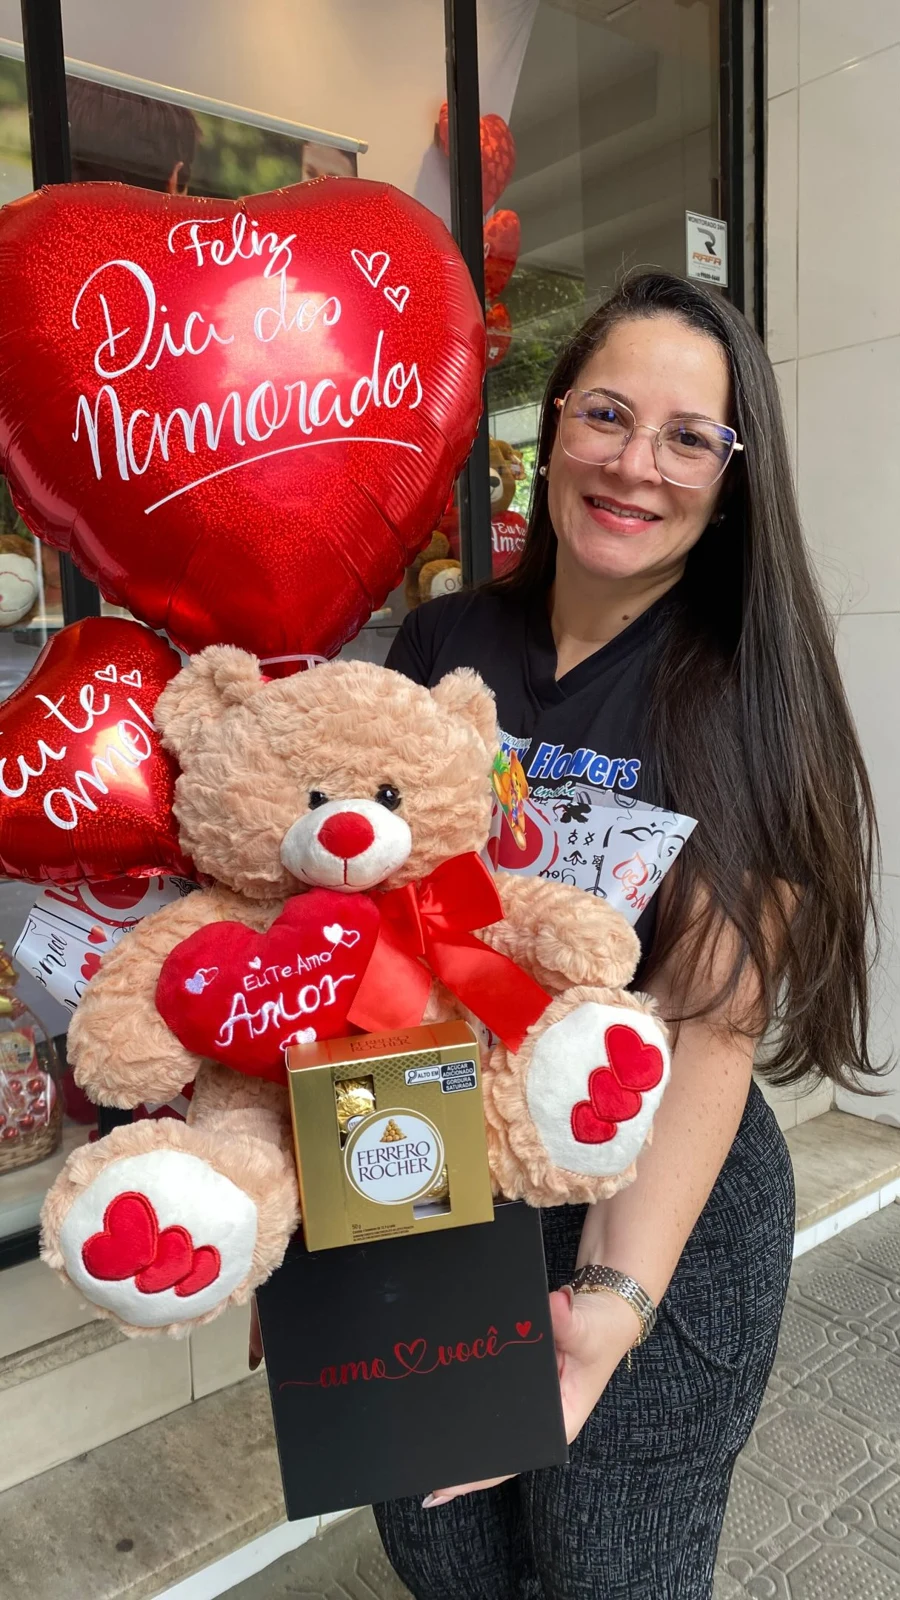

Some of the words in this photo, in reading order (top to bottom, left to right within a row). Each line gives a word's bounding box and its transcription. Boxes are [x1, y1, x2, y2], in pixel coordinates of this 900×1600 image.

[168, 212, 297, 278] Feliz
[72, 260, 234, 379] Dia
[254, 268, 342, 342] dos
[72, 330, 423, 481] Namorados
[35, 684, 110, 733] te
[297, 951, 333, 976] Amo
[215, 974, 356, 1047] Amor
[443, 1068, 474, 1077] ADICIONADO
[446, 1076, 472, 1085] GORDURA
[446, 1082, 473, 1091] SATURADA
[357, 1140, 431, 1166] FERRERO
[358, 1157, 433, 1182] ROCHER
[319, 1357, 386, 1388] amo
[437, 1325, 501, 1366] você
